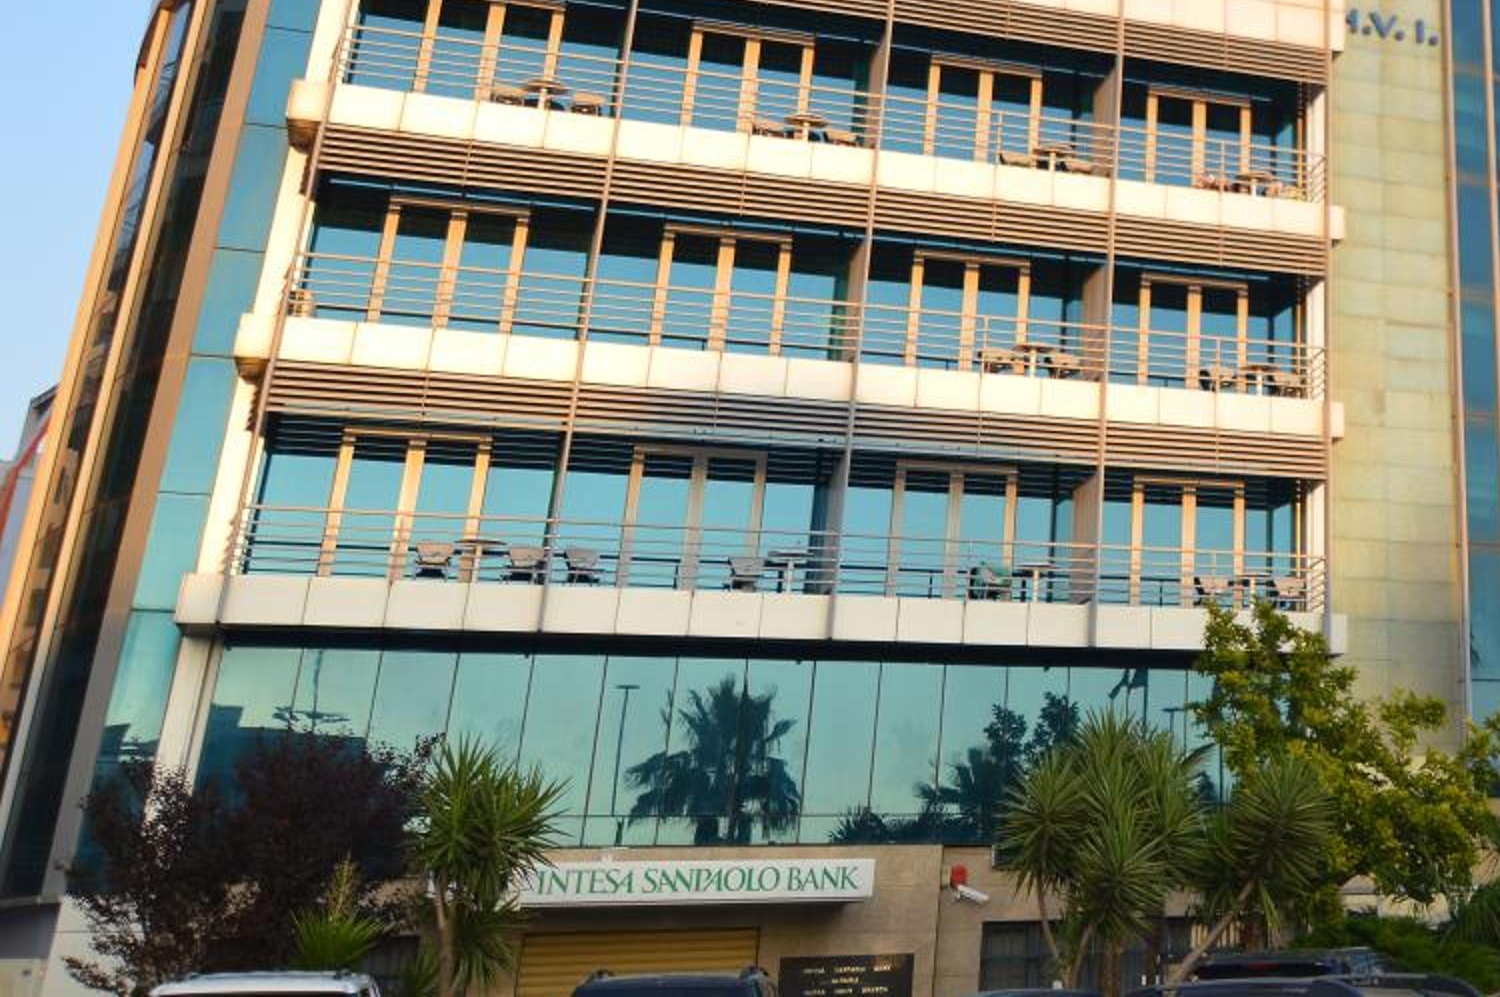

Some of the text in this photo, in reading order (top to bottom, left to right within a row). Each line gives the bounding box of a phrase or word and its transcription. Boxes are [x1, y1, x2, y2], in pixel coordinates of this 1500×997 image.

[537, 866, 859, 895] INTESA SANPAOLO BANK
